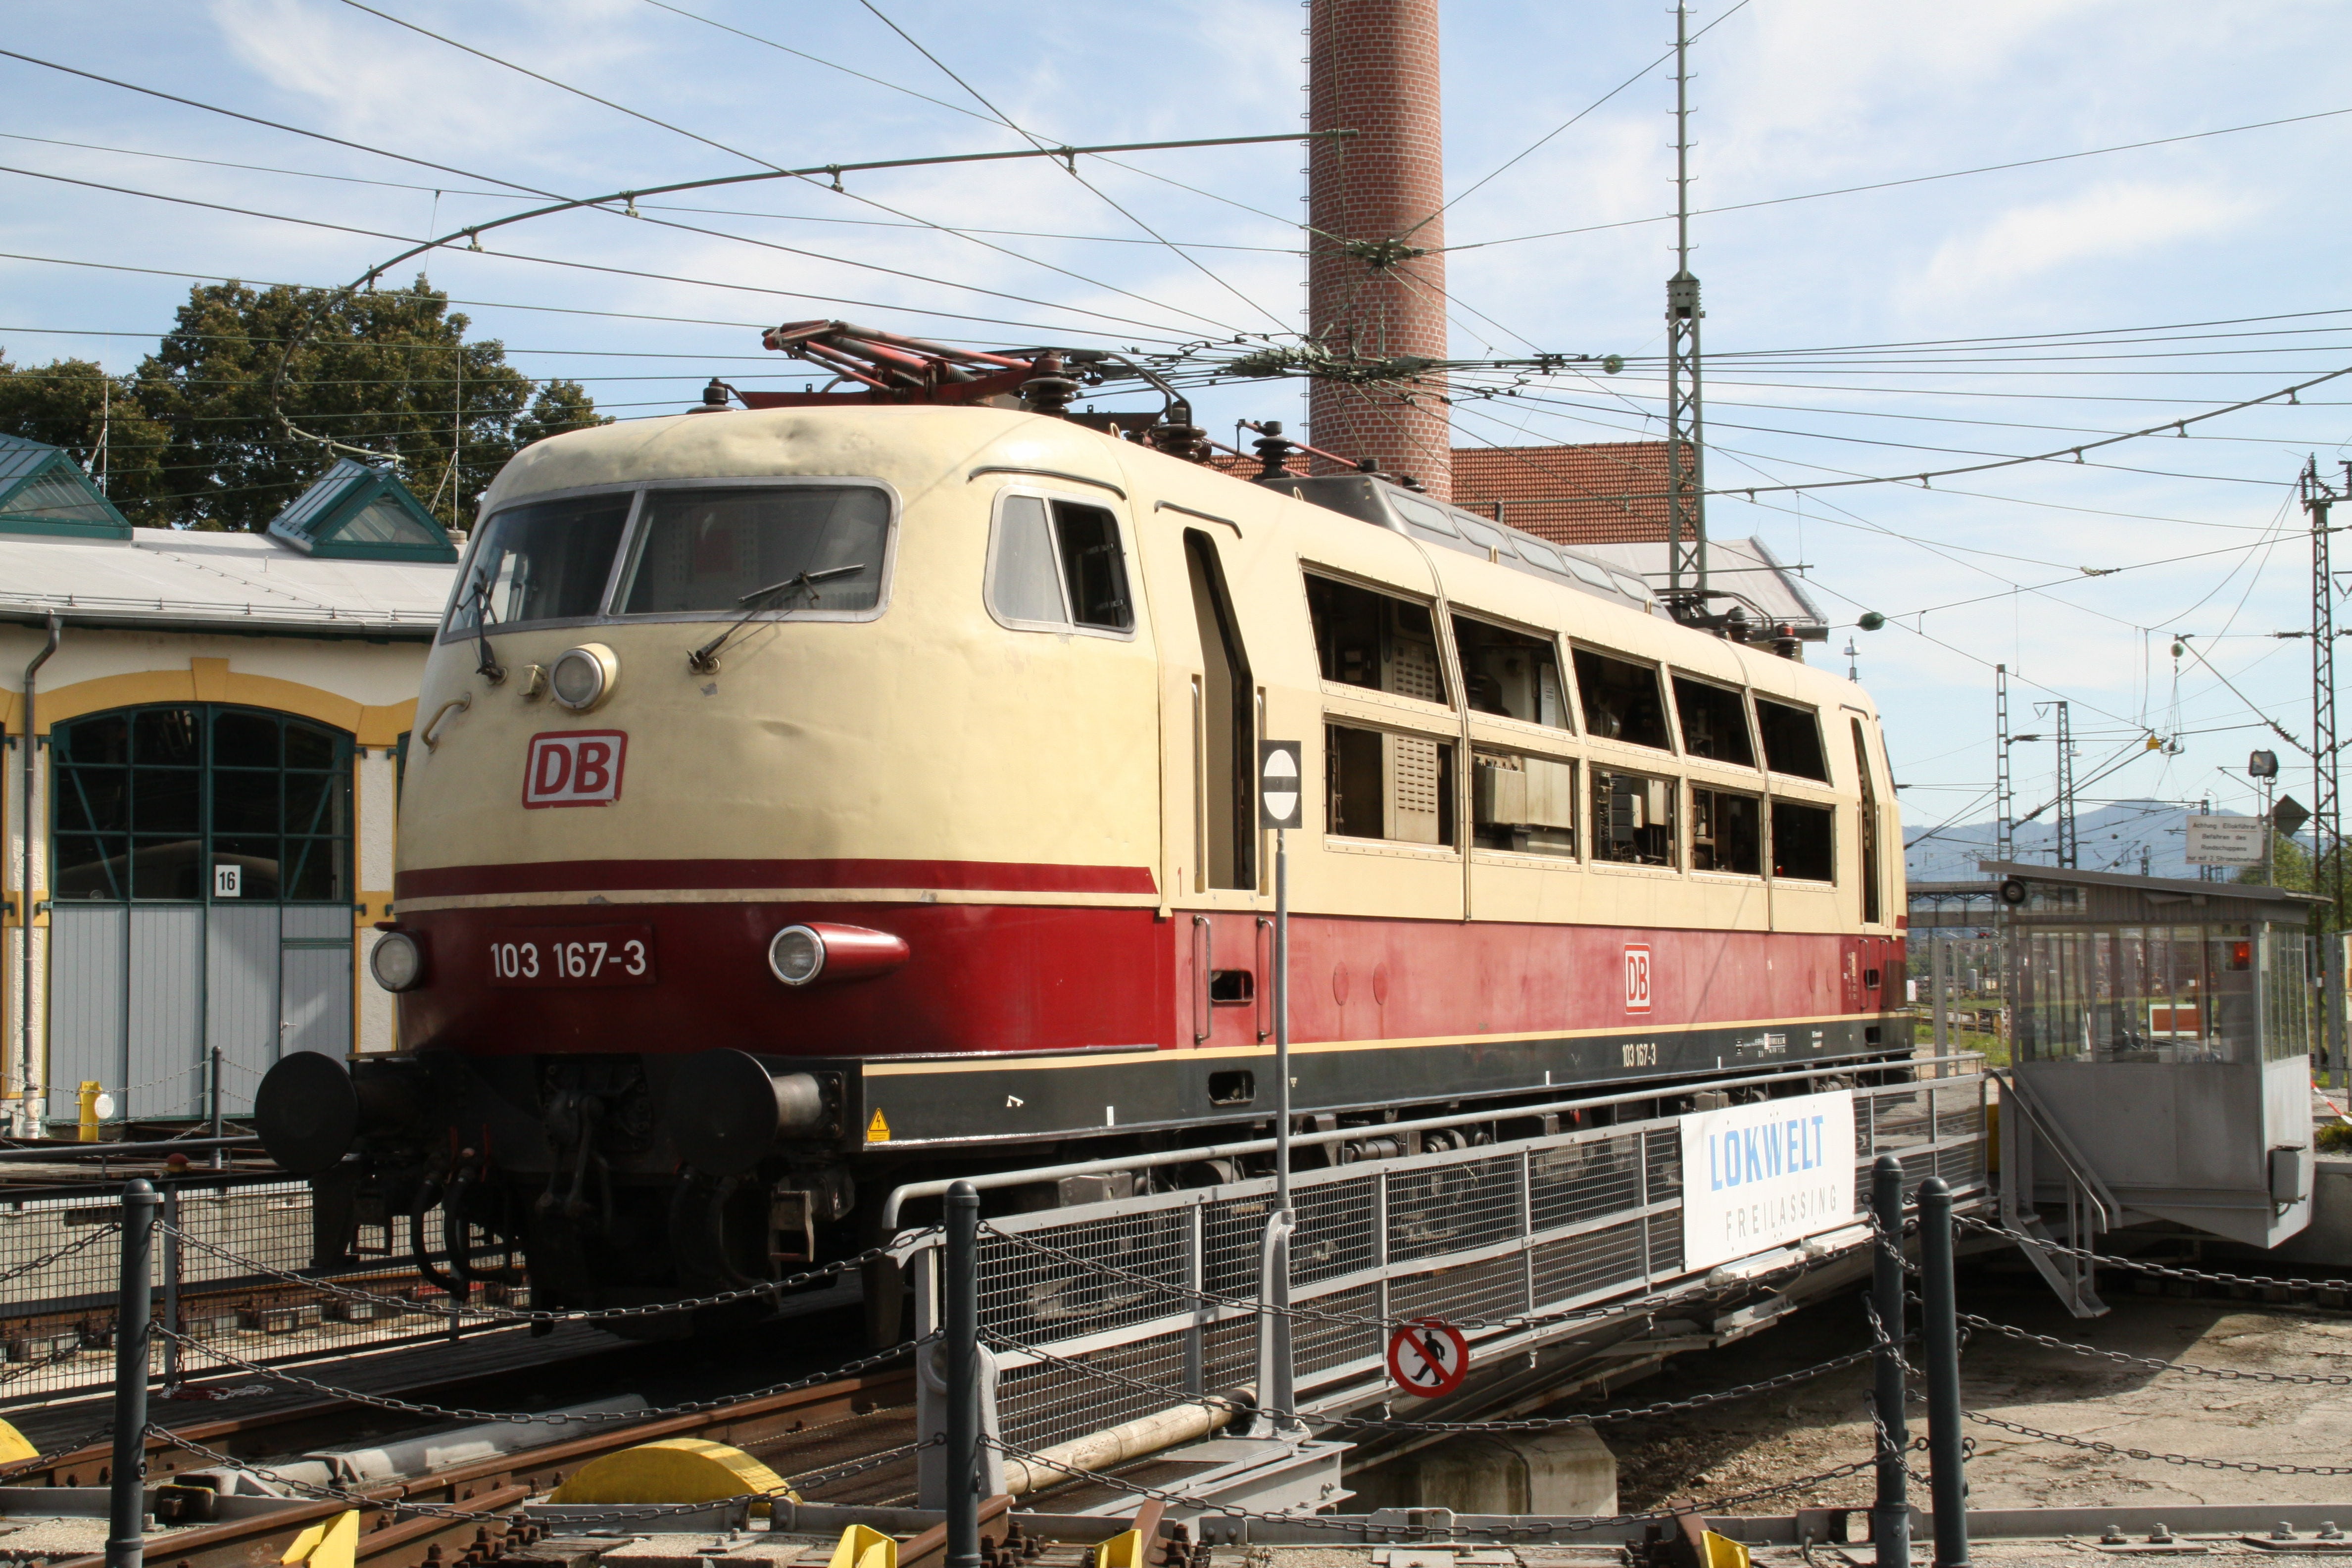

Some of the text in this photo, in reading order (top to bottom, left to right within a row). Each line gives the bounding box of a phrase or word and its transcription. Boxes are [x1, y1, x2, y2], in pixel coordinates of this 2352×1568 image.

[534, 742, 612, 795] DB
[219, 872, 236, 890] 16
[1177, 867, 1181, 897] 1
[490, 939, 646, 978] 103 167-3
[1627, 956, 1648, 1001] DB
[1622, 1042, 1656, 1067] 103 167-3
[1709, 1114, 1824, 1192] LOKWELT
[1726, 1184, 1837, 1240] FREILASSING
